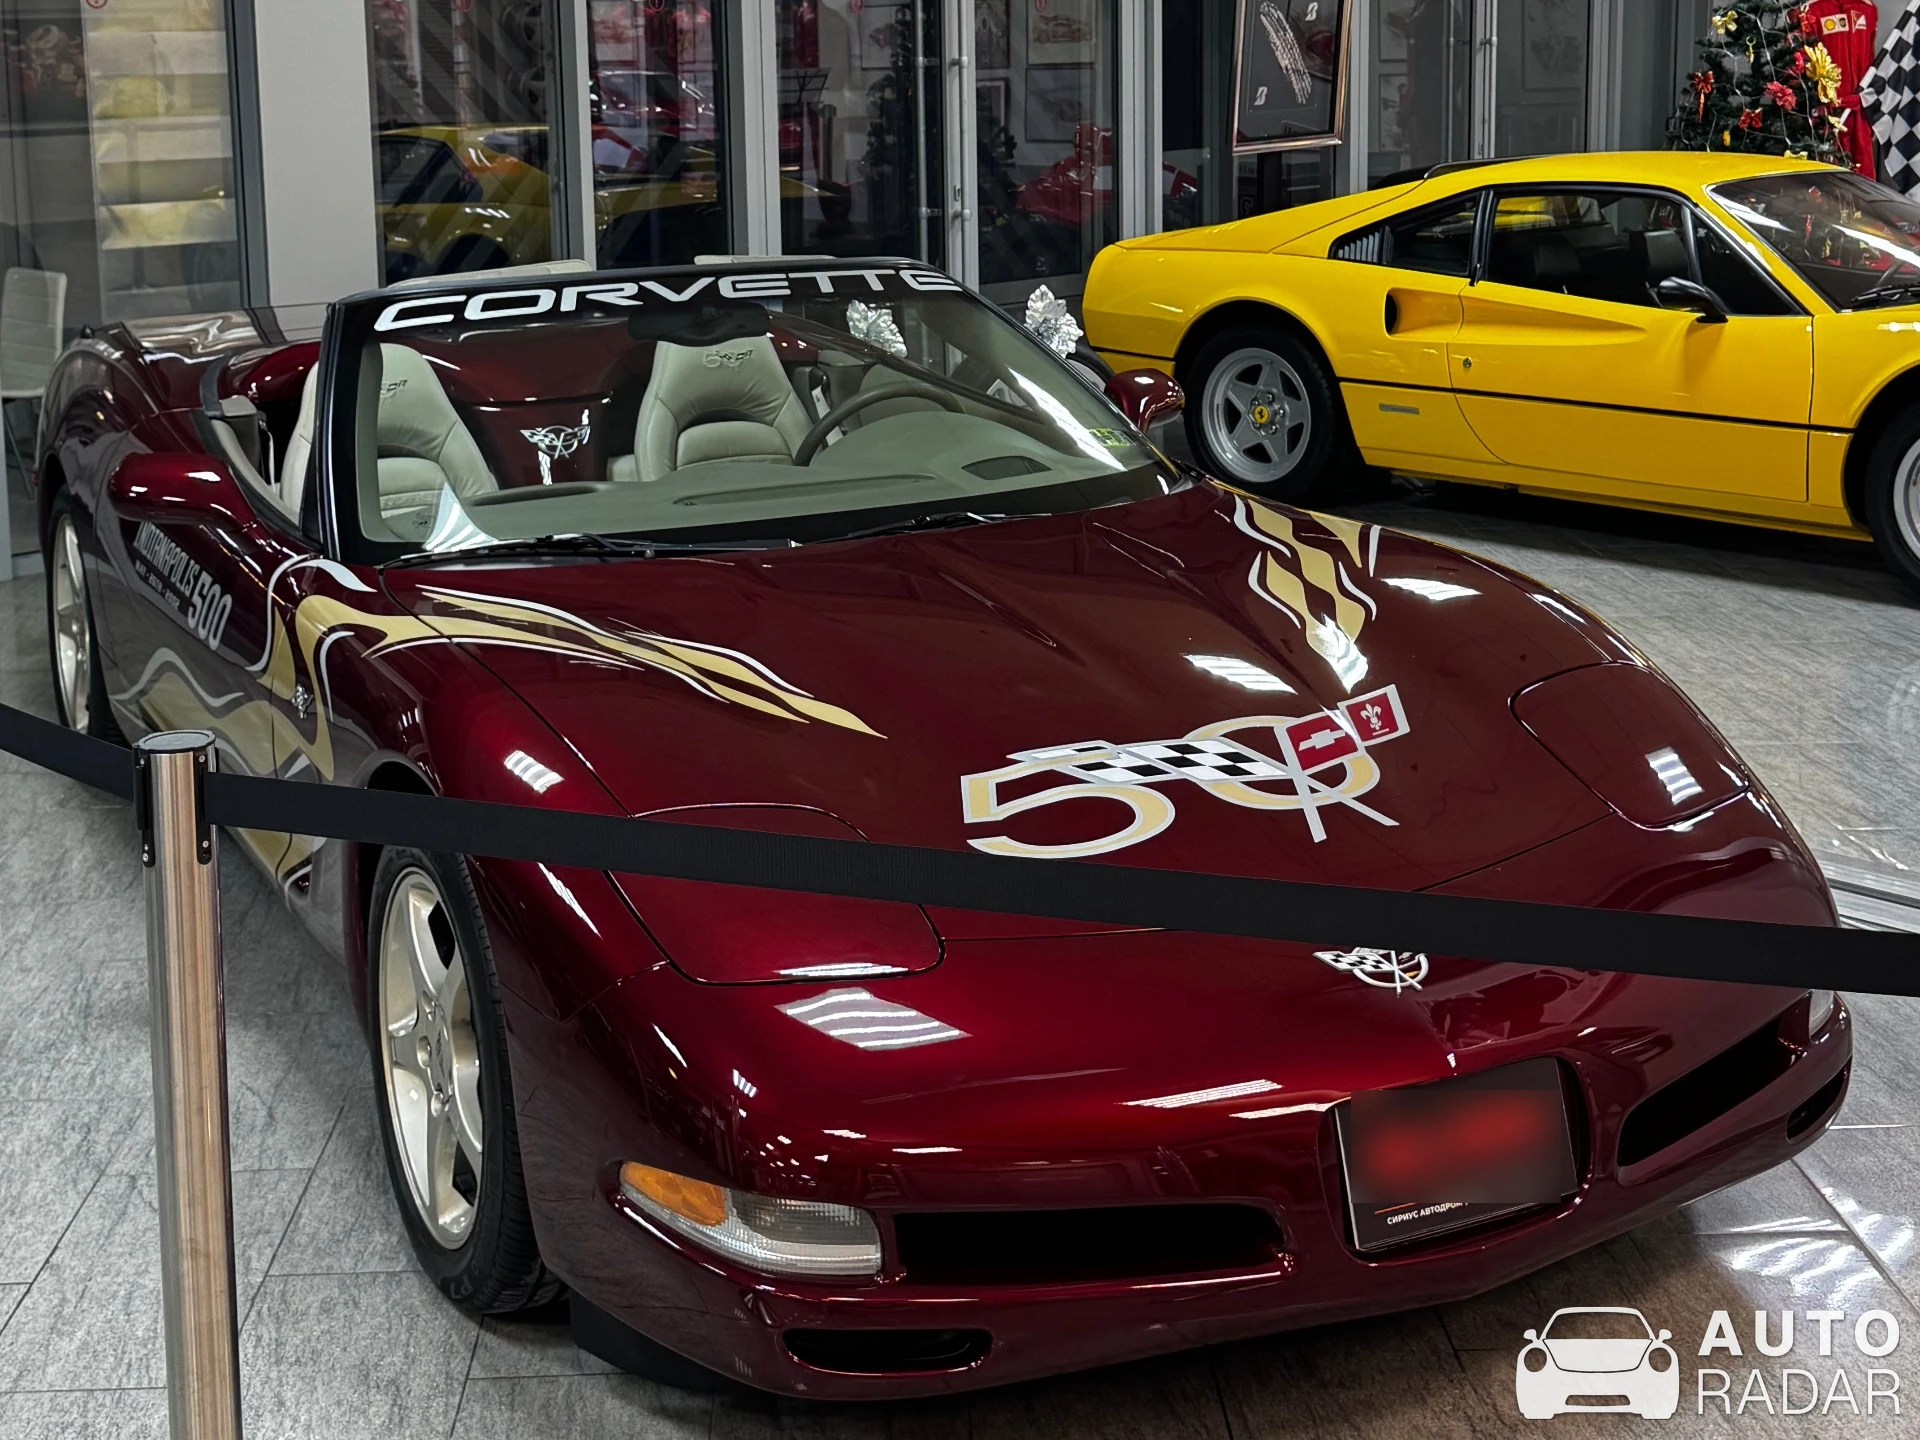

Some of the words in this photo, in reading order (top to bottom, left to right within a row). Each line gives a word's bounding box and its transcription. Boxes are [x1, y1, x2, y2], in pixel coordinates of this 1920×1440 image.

[374, 268, 963, 331] CORVETTE
[133, 521, 201, 598] INDIANAPOLIS
[187, 570, 232, 651] 500
[1387, 1210, 1419, 1225] СИРИУС
